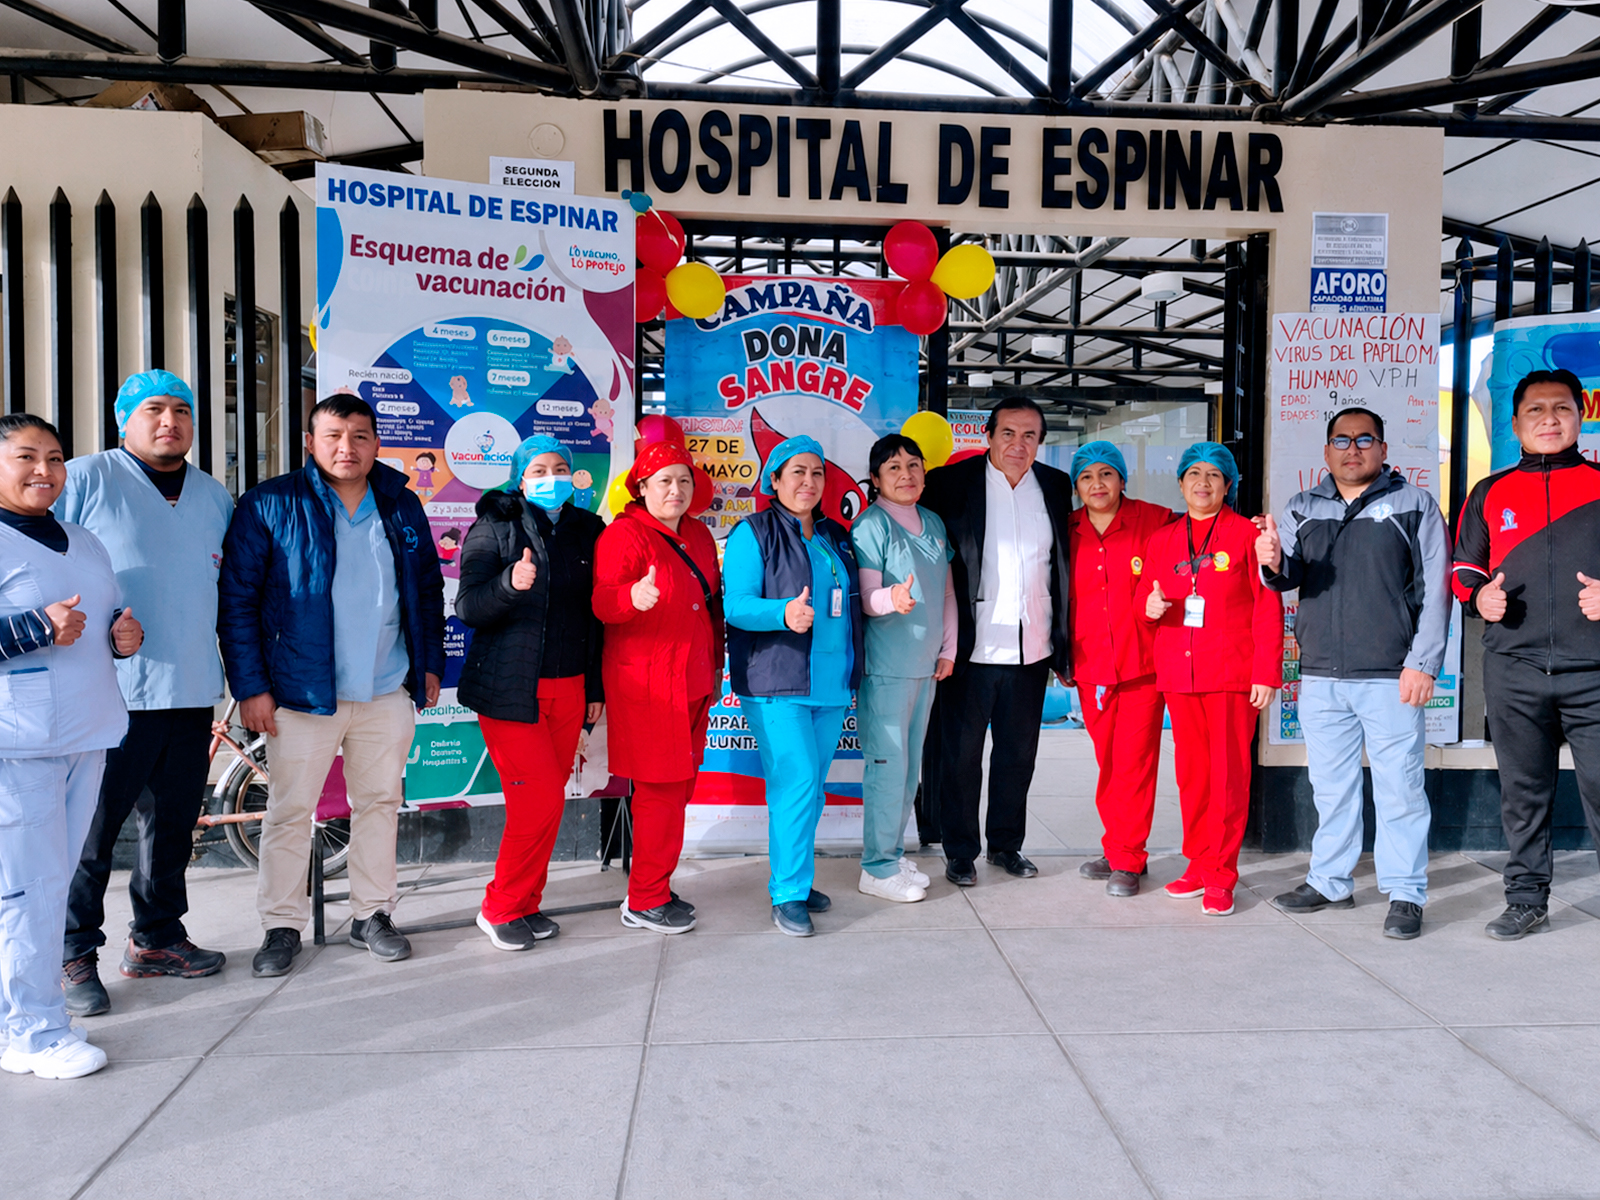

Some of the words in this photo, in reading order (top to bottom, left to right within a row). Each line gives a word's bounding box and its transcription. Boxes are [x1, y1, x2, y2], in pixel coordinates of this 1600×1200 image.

[602, 108, 909, 204] HOSPITAL
[937, 123, 1011, 208] DE
[1041, 126, 1285, 213] ESPINAR
[504, 165, 559, 178] SEGUNDA
[502, 176, 561, 189] ELECCIÓN
[328, 178, 461, 215] HOSPITAL
[468, 194, 503, 221] DE
[510, 200, 619, 233] ESPINAR
[349, 234, 472, 268] Esquema
[477, 246, 510, 271] de
[415, 273, 567, 303] vacunación
[1314, 272, 1386, 295] AFORO
[440, 328, 469, 337] meses
[1279, 313, 1425, 342] VACUNACIÓN
[492, 334, 498, 342] 6
[499, 336, 527, 344] meses
[743, 325, 847, 365] DONA
[1274, 345, 1323, 363] VIRUS
[1330, 344, 1355, 362] DEL
[348, 369, 378, 379] Recién
[380, 370, 410, 381] nacido
[498, 374, 527, 383] meses
[1288, 368, 1358, 390] HUMANO
[718, 361, 873, 412] SANGRE
[1280, 394, 1311, 407] EDAD:
[1329, 390, 1338, 406] 9
[380, 403, 386, 411] 2
[388, 404, 416, 412] meses
[688, 439, 709, 453] 27
[716, 439, 739, 454] DE
[451, 450, 513, 462] Vacunación
[702, 463, 753, 478] MAYO
[724, 499, 753, 513] AM
